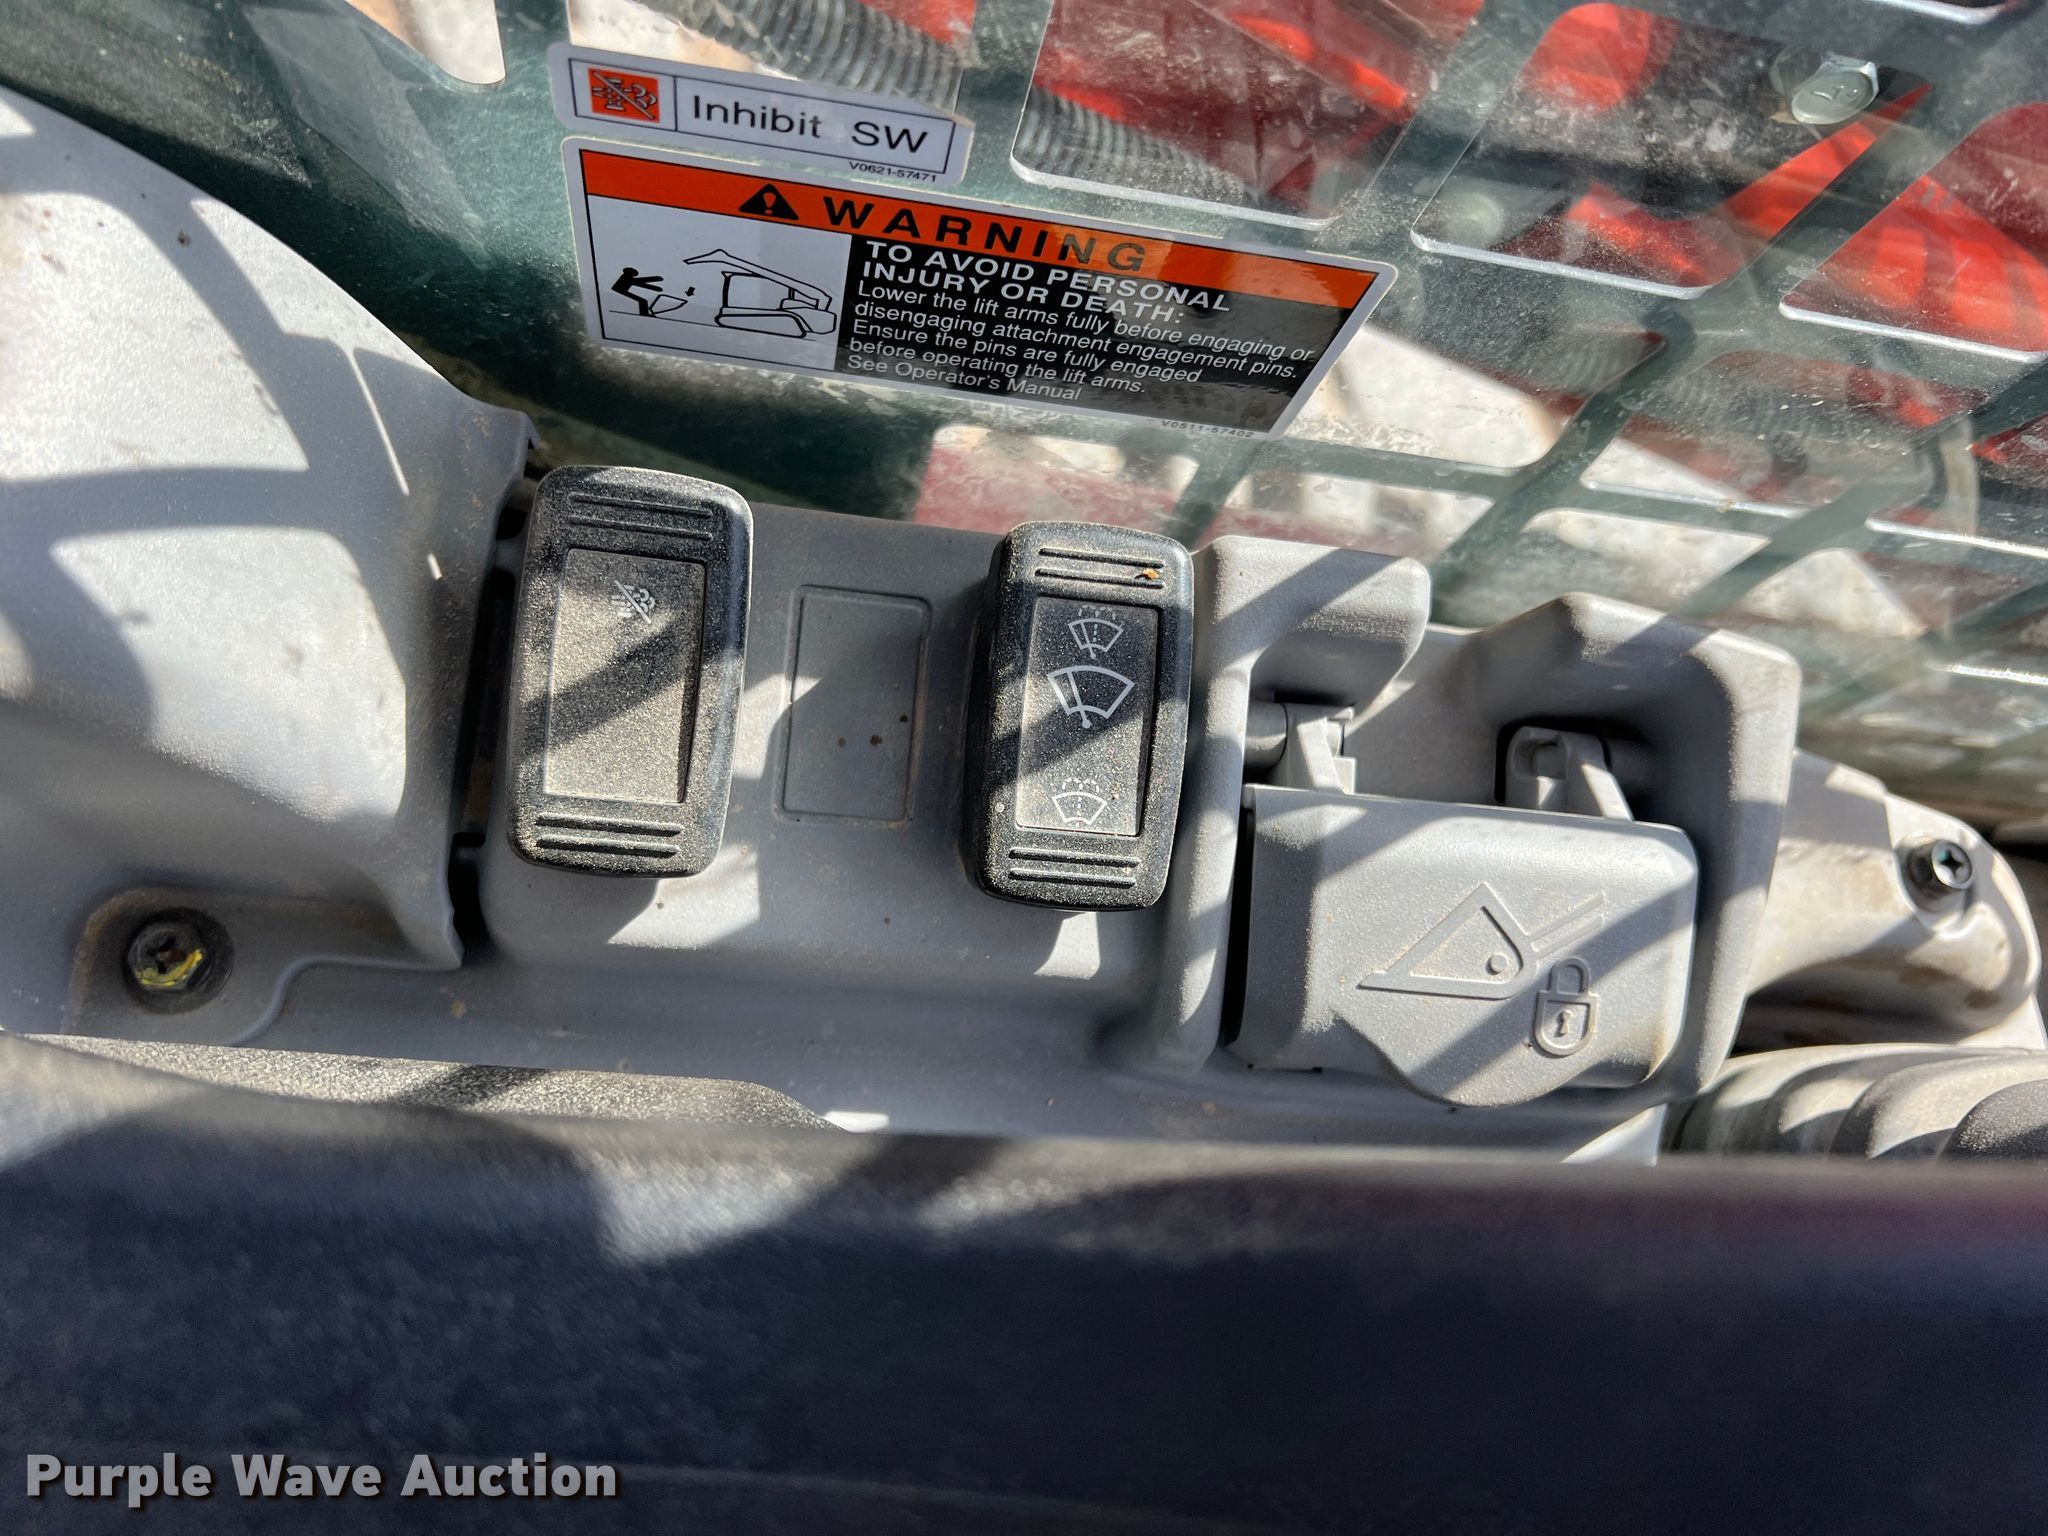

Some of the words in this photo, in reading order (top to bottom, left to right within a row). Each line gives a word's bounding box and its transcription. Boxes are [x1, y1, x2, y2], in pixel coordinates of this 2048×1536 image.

[694, 95, 822, 139] Inhibit
[851, 120, 928, 154] SW
[849, 161, 937, 182] V0621-57471
[823, 196, 1147, 272] WARNING
[863, 261, 991, 294] INJURY
[1001, 283, 1049, 304] OR
[1061, 291, 1184, 324] DEATH:
[866, 240, 913, 262] TO
[924, 251, 1035, 281] AVOID
[1047, 269, 1230, 312] PERSONAL
[853, 318, 928, 343] Ensure
[935, 332, 968, 349] the
[972, 339, 1017, 357] pins
[1023, 347, 1057, 362] are
[1064, 348, 1105, 372] fully
[1110, 359, 1203, 383] engaged
[854, 301, 986, 337] disengaging
[992, 324, 1112, 352] attachment
[1116, 341, 1247, 372] engagement
[1248, 359, 1297, 378] pins.
[858, 280, 927, 304] Lower
[933, 292, 967, 311] the
[974, 297, 1000, 316] lift
[1004, 306, 1059, 325] arms
[1065, 311, 1109, 336] fully
[1114, 320, 1183, 343] before
[1188, 332, 1286, 362] engaging
[1290, 346, 1315, 362] or
[848, 355, 888, 373] See
[895, 362, 1000, 390] Operator's
[1006, 378, 1082, 401] Manual
[849, 337, 916, 359] before
[922, 351, 1019, 378] operating
[1025, 363, 1057, 380] the
[1062, 368, 1086, 385] lift
[1091, 374, 1146, 393] arms.
